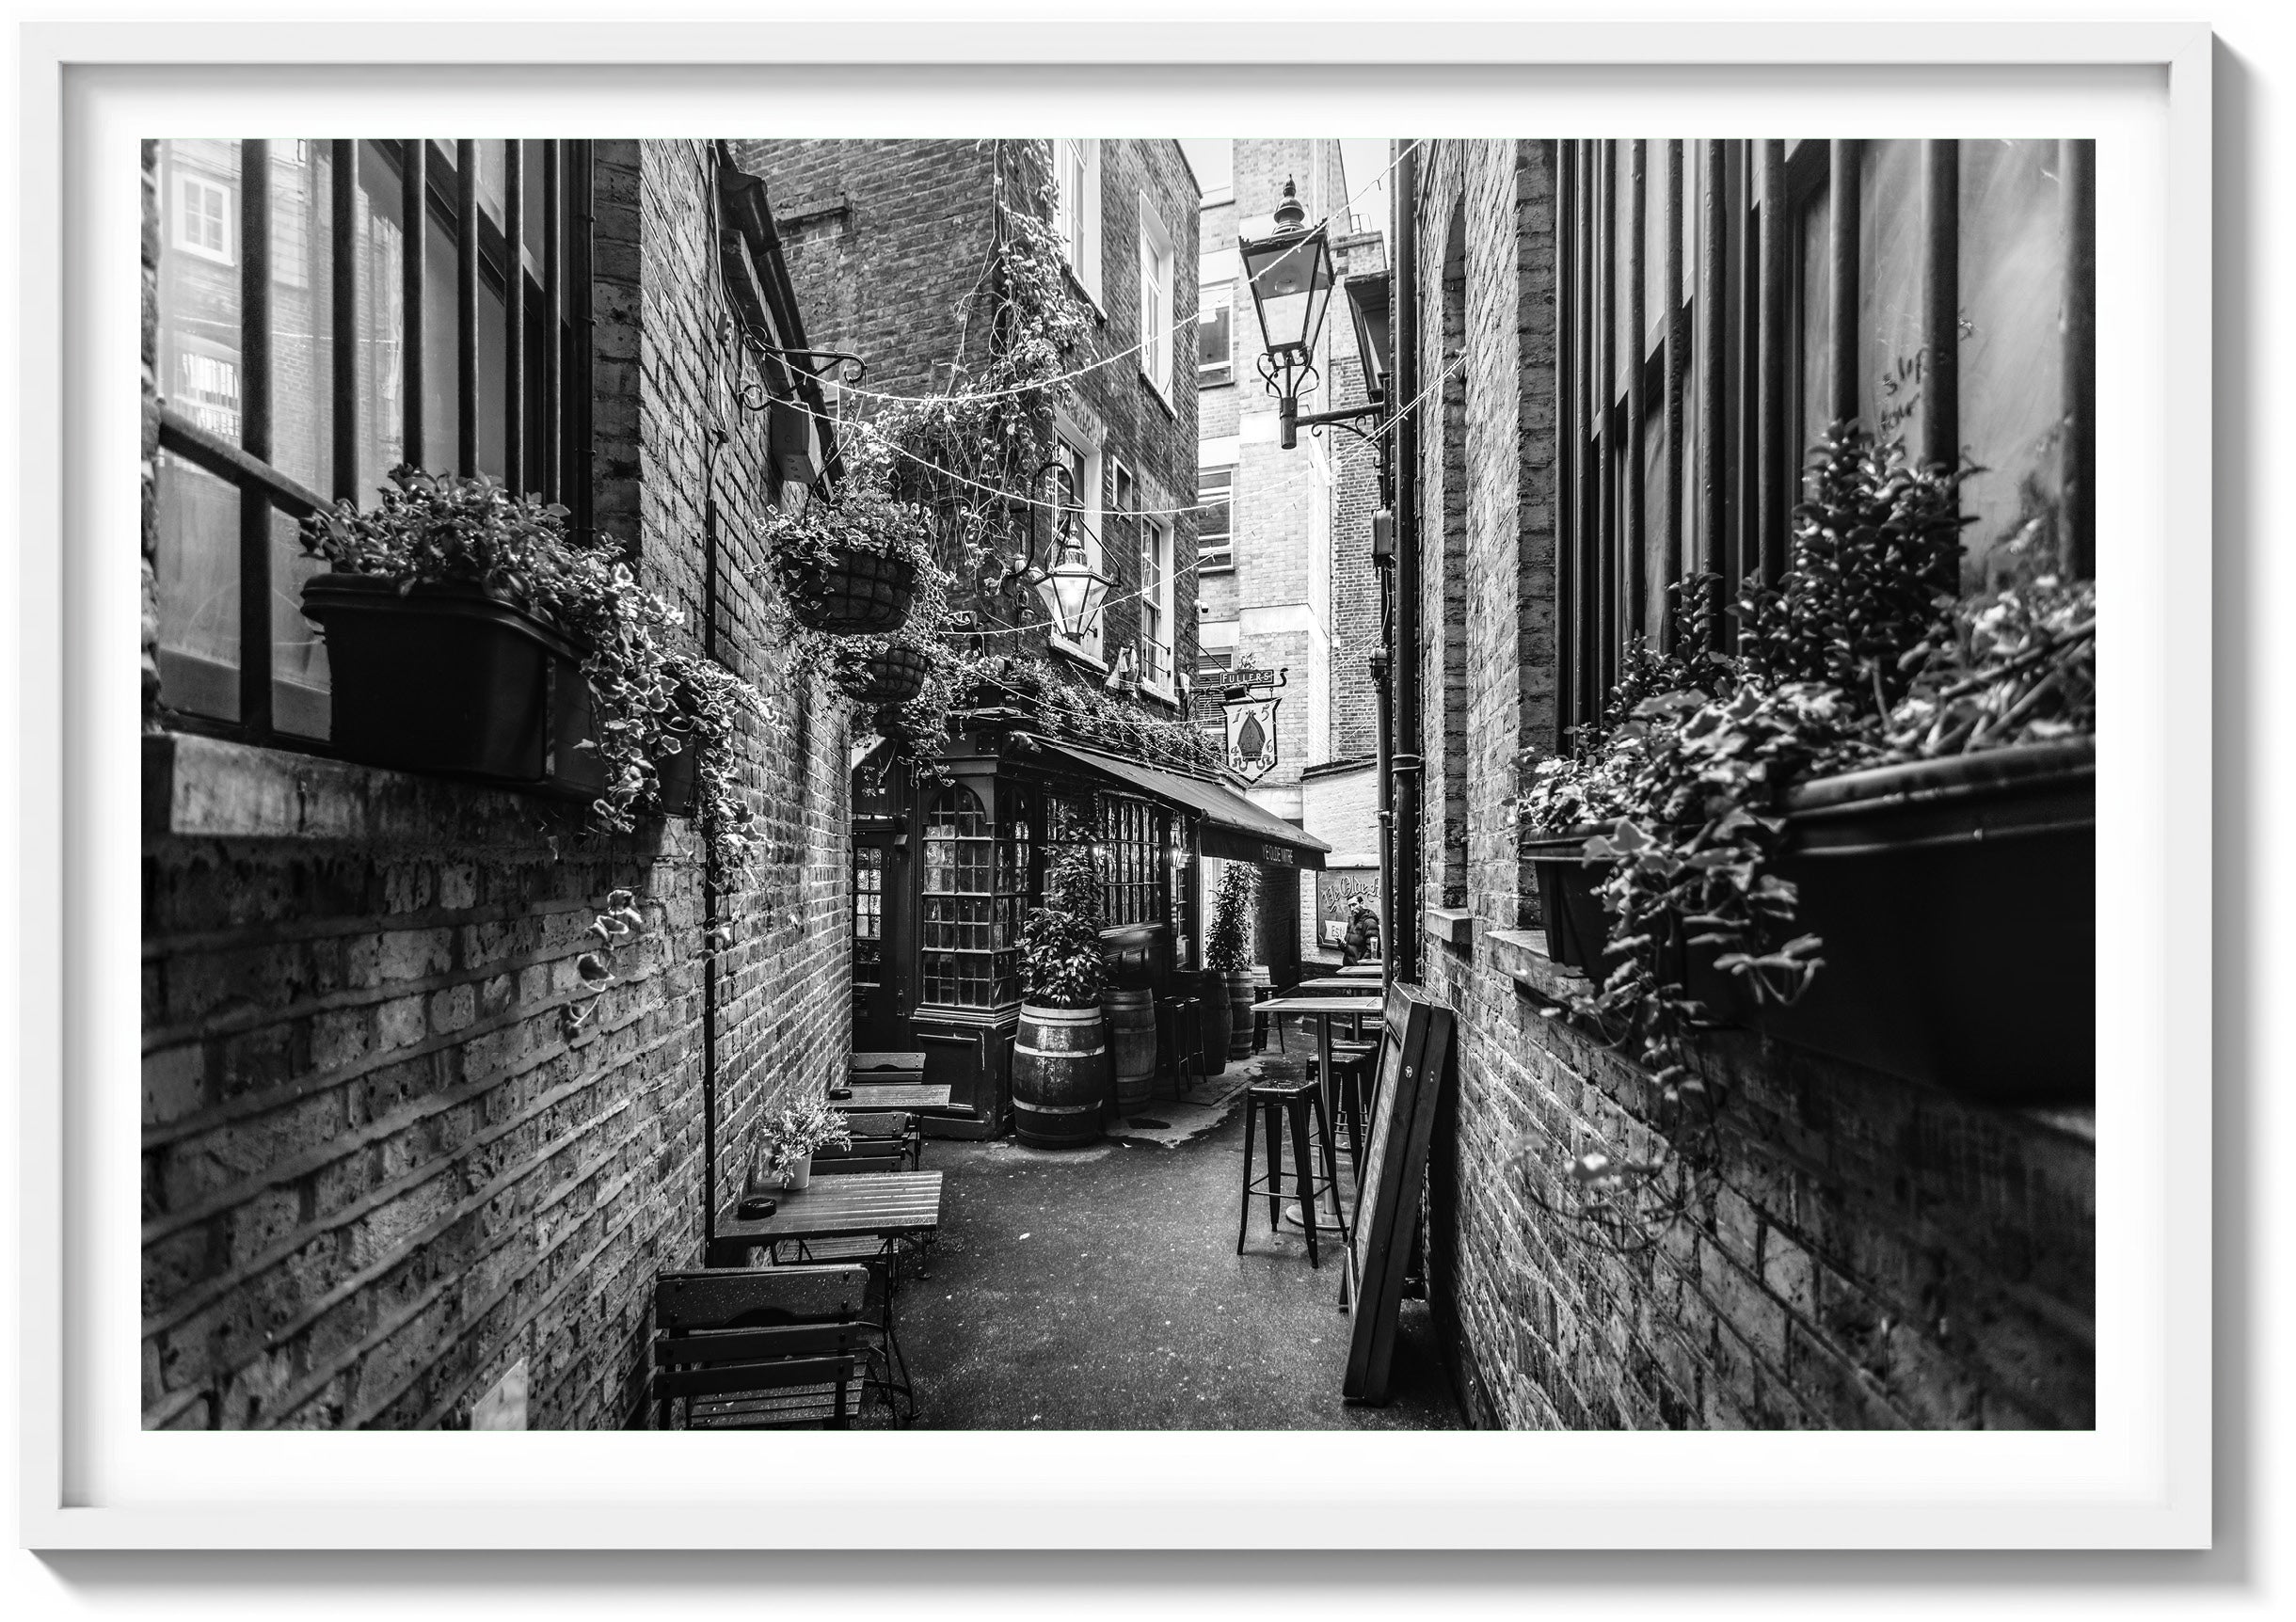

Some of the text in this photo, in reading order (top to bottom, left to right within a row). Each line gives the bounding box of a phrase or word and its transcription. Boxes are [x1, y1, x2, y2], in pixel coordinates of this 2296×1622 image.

[1233, 704, 1269, 724] 1 5
[1231, 739, 1273, 755] 4 6
